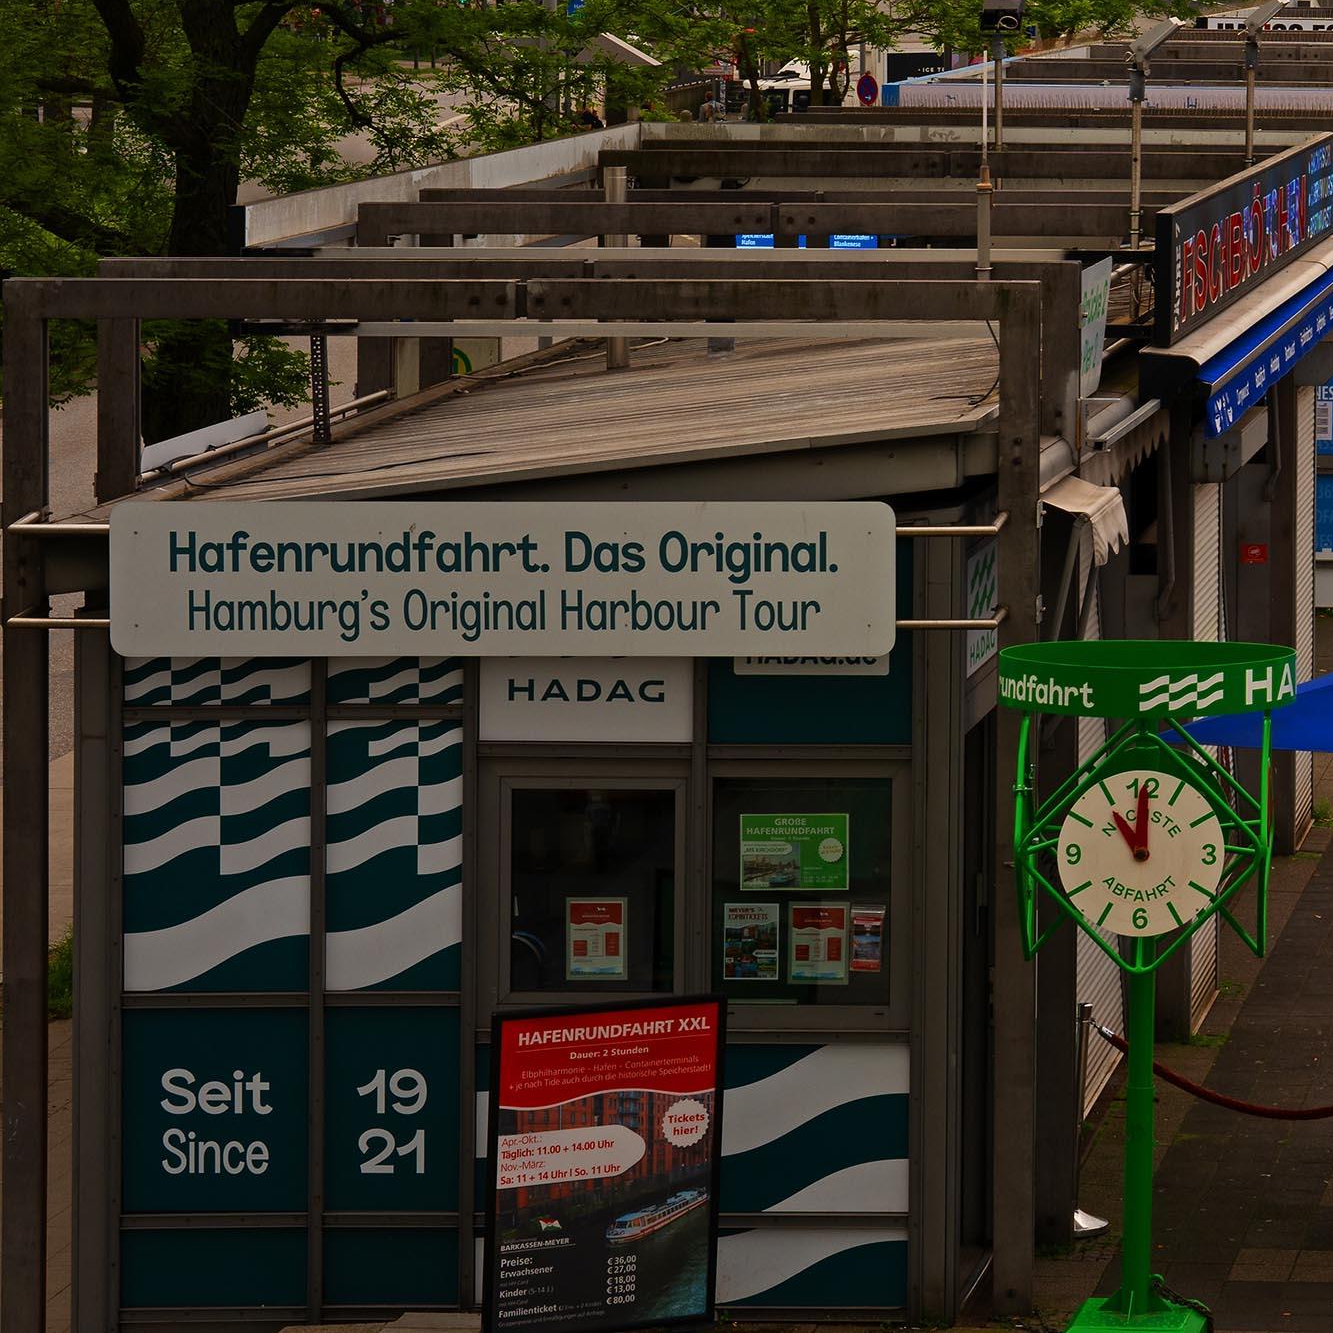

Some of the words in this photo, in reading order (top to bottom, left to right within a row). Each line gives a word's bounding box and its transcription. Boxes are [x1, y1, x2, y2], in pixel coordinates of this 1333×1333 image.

[169, 530, 549, 572] Hafenrundfahrt.
[564, 531, 646, 573] Das
[658, 530, 840, 584] Original.
[188, 588, 390, 642] Hamburg's
[402, 587, 546, 642] Original
[560, 589, 722, 632] Harbour
[734, 590, 822, 633] Tour
[969, 631, 996, 664] HADAG
[508, 678, 667, 704] HADAG
[1126, 778, 1160, 799] 12
[746, 827, 836, 836] HAFENRUNDFAHRT
[774, 818, 808, 826] GROßE
[1065, 843, 1081, 865] 9
[1201, 844, 1217, 865] 3
[1102, 875, 1176, 902] ABFAHRT
[1132, 907, 1148, 929] 6
[518, 1019, 674, 1047] HAFENRUNDFAHRT
[678, 1016, 711, 1032] XXL
[570, 1049, 600, 1060] Dauer:
[610, 1046, 649, 1056] Stunden
[522, 1066, 586, 1080] Elbphilharmonie
[594, 1062, 617, 1071] Hafen
[624, 1054, 700, 1069] Containerterminals
[618, 1068, 657, 1080] historische
[658, 1064, 712, 1077] Speicherstadt!
[160, 1068, 273, 1116] Seit
[357, 1069, 428, 1116] 19
[668, 1112, 706, 1124] Tickets
[672, 1126, 698, 1137] hier!
[160, 1128, 270, 1175] Since
[357, 1129, 429, 1175] 21
[501, 1148, 534, 1161] Täglich:
[538, 1145, 561, 1156] 11.00
[572, 1142, 596, 1152] 14.00
[500, 1176, 514, 1186] Sa:
[574, 1168, 588, 1178] So.
[500, 1237, 570, 1253] BARKASSEN-MEYER
[500, 1257, 534, 1268] Preise:
[500, 1266, 554, 1280] Erwachsener
[500, 1288, 528, 1299] Kinder
[498, 1304, 564, 1319] Familienticket
